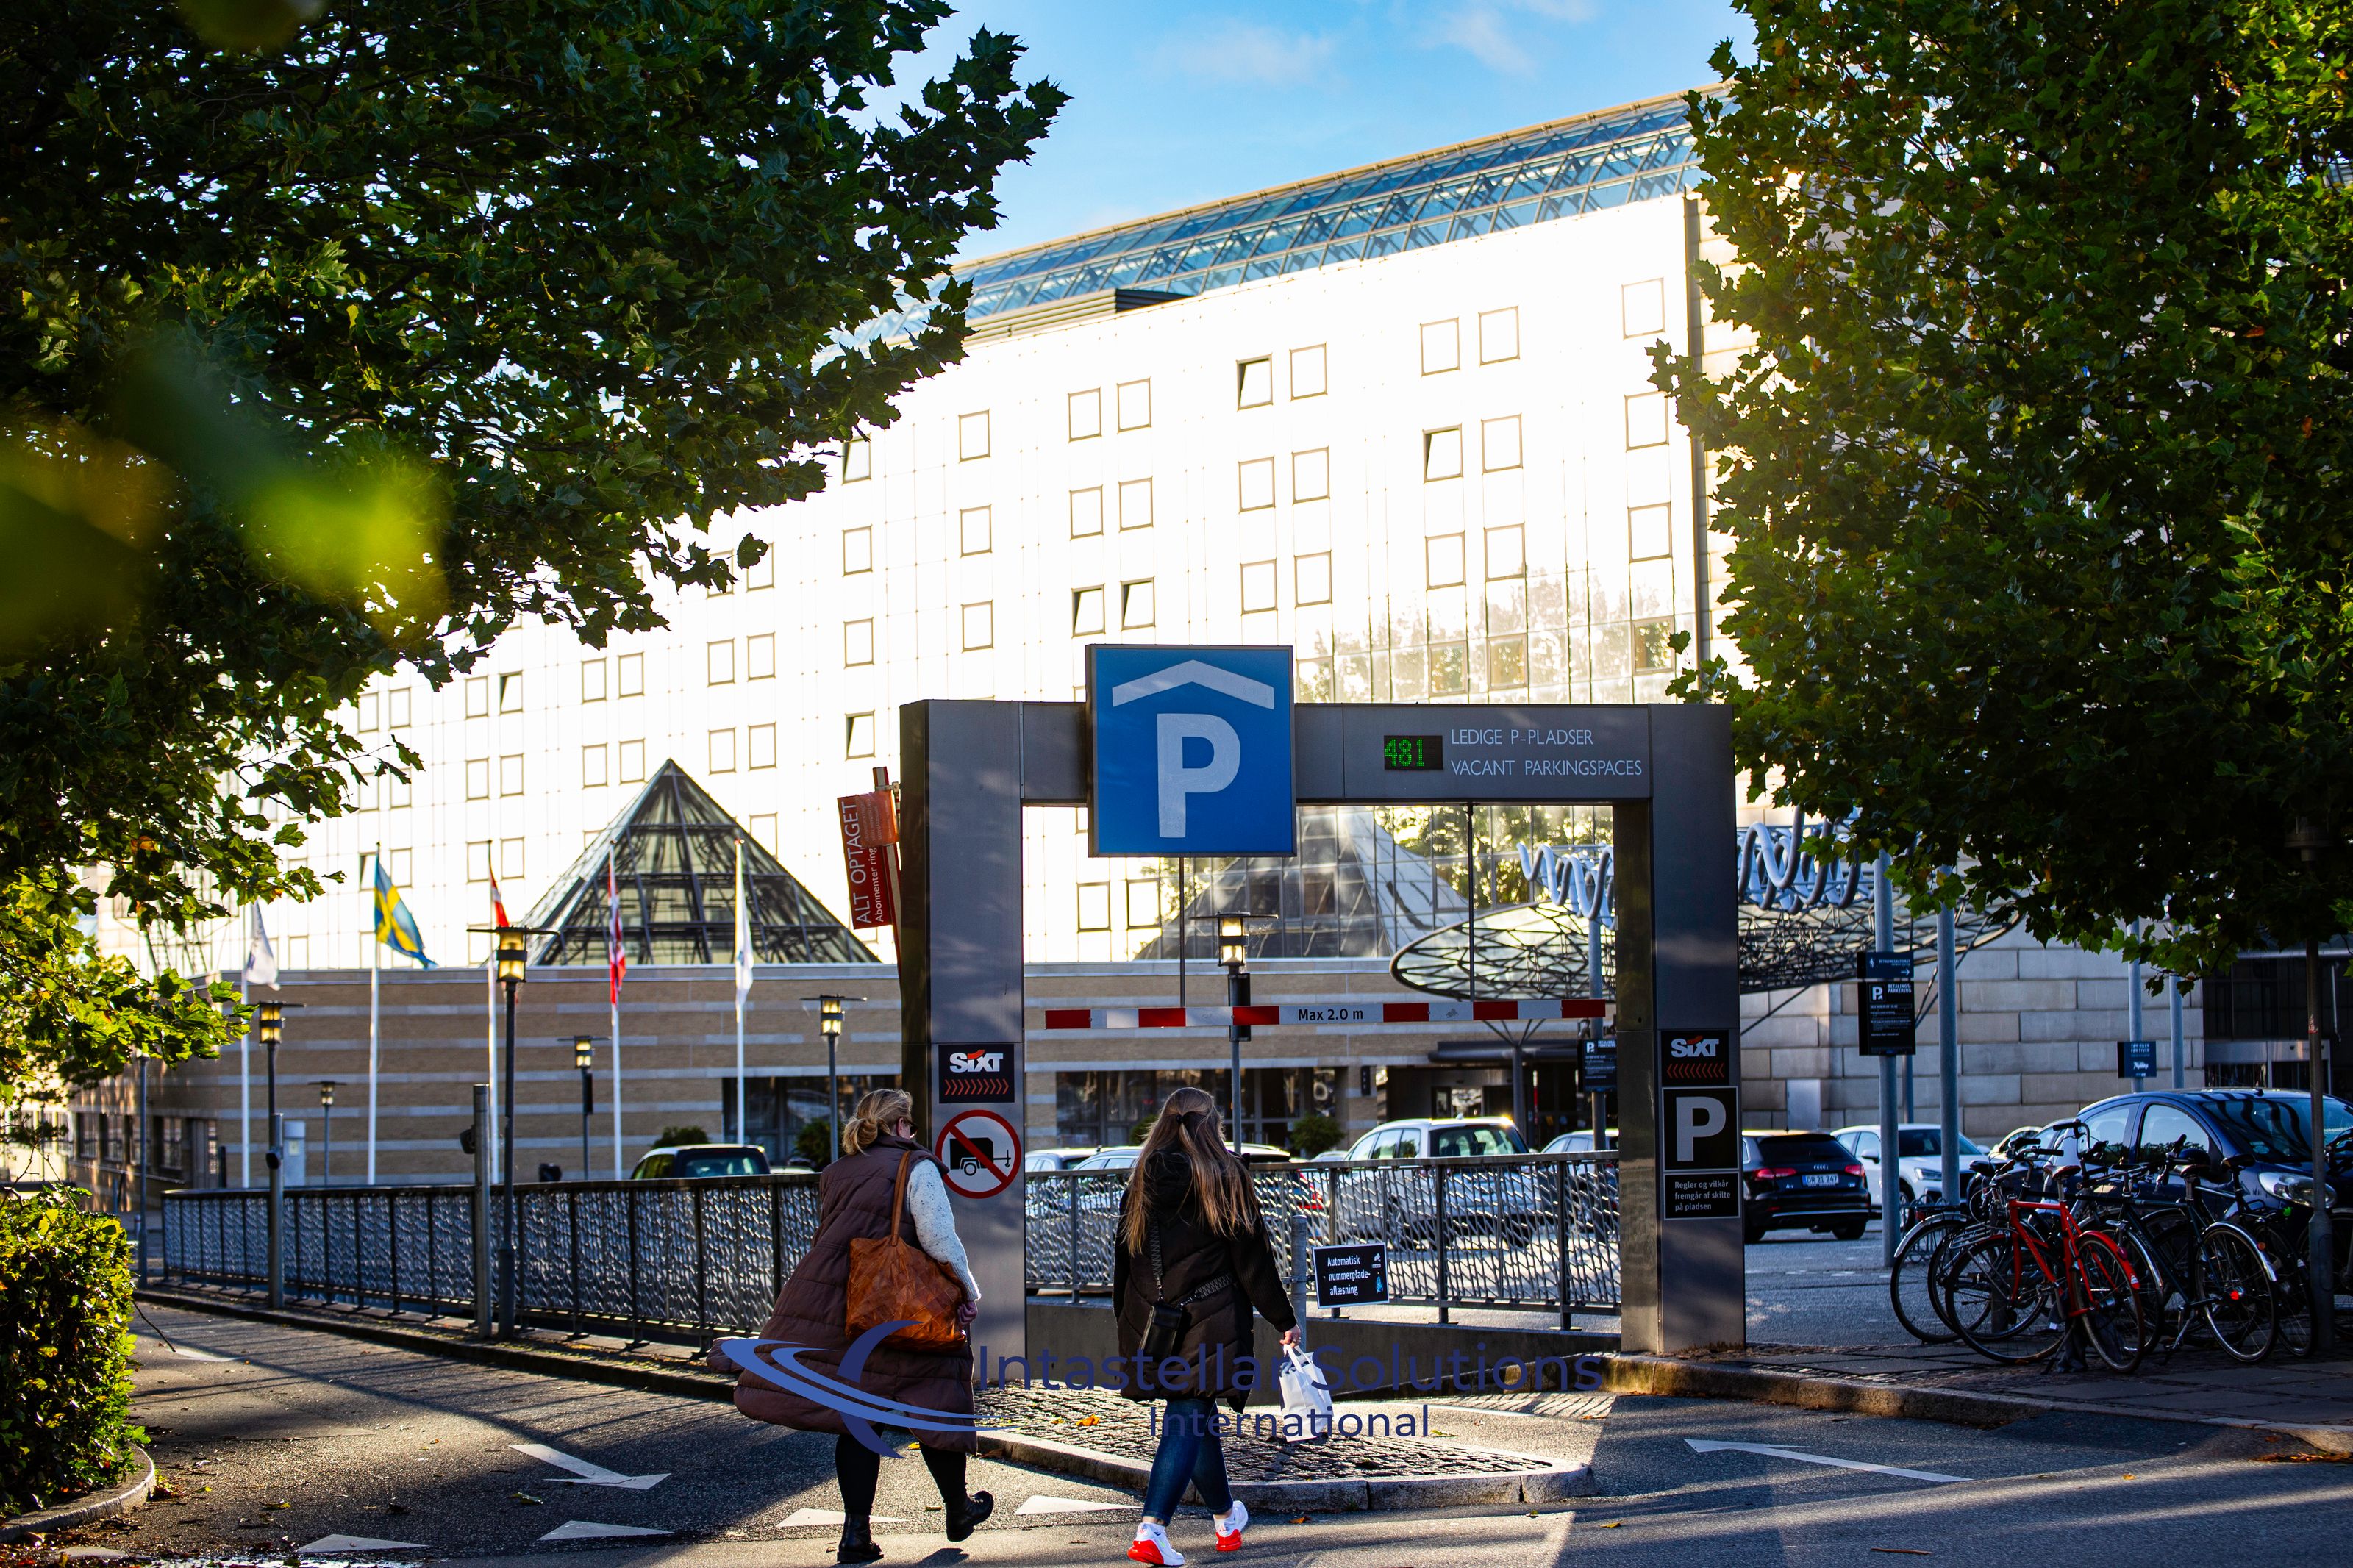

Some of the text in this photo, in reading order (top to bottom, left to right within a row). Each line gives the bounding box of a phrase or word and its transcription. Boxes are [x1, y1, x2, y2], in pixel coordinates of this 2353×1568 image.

[1451, 729, 1593, 745] LEDIGE P-PLADSER
[1385, 738, 1424, 767] 481
[1157, 713, 1241, 838] P
[1451, 760, 1642, 776] VACANT PARKINGSPACES
[841, 801, 872, 924] ALT OPTAGET
[869, 847, 878, 864] ring
[871, 867, 884, 923] Abonnenter
[1298, 1008, 1363, 1020] Max 2.0 m
[1676, 1096, 1727, 1162] P
[1674, 1179, 1729, 1190] Regler og vilkår
[1674, 1191, 1702, 1200] fremgår
[1711, 1191, 1731, 1199] skilte
[1675, 1202, 1712, 1212] på pladsen
[1327, 1255, 1360, 1267] Automatisk
[1329, 1269, 1371, 1281] nummerplade-
[1329, 1284, 1358, 1296] aflæsning
